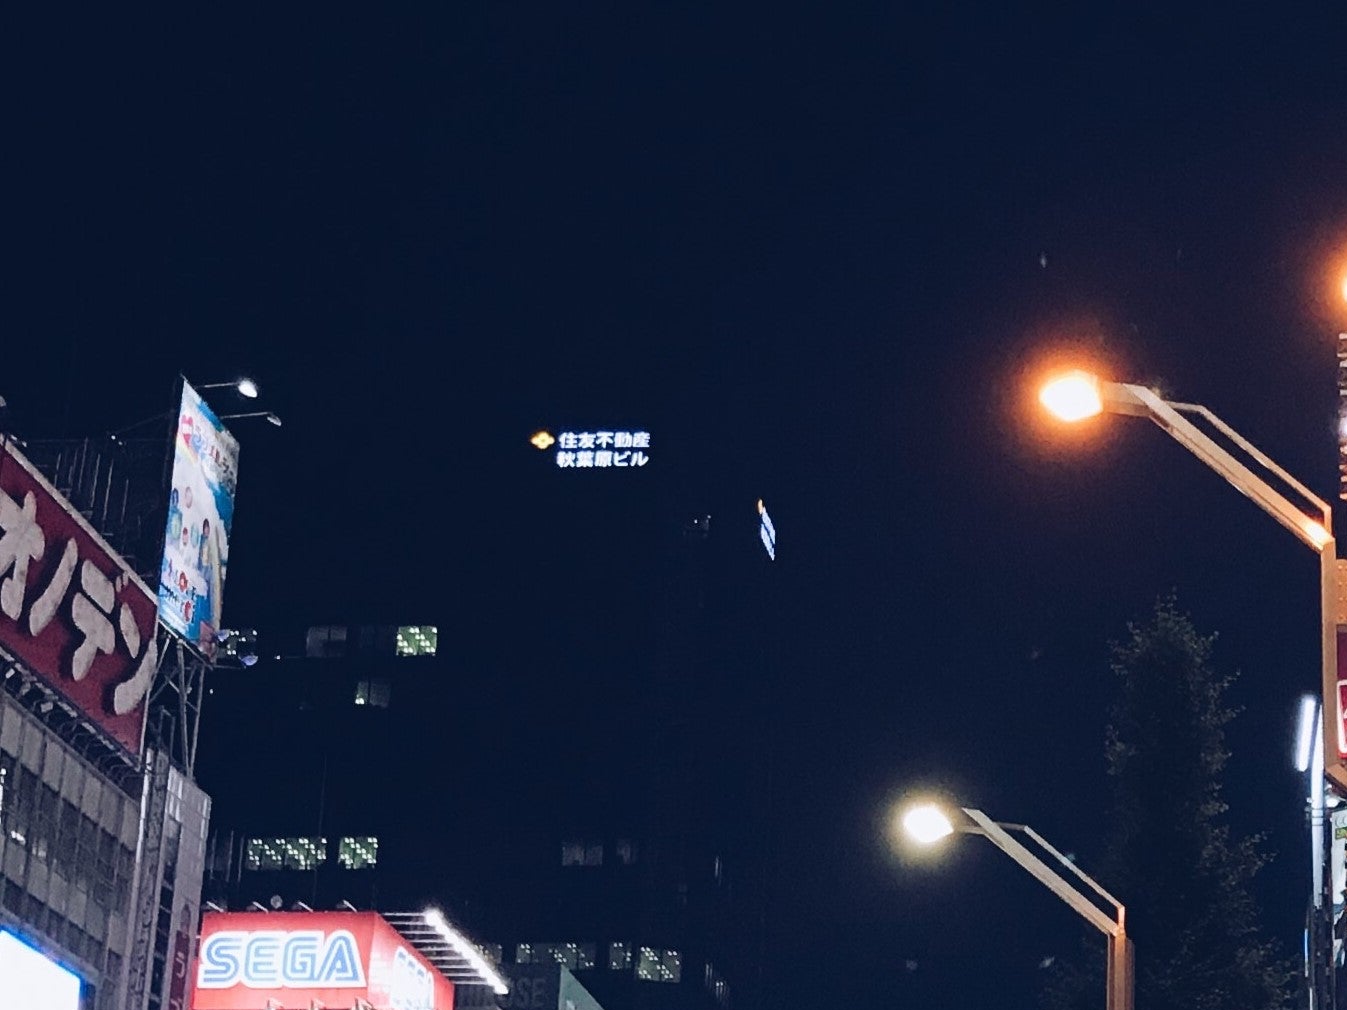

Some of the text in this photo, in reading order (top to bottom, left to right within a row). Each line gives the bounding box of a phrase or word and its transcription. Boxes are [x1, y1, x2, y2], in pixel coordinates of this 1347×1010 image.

[558, 431, 651, 449] 住友不動産
[556, 450, 650, 468] 秋葉原ビル
[199, 930, 368, 989] SEGA
